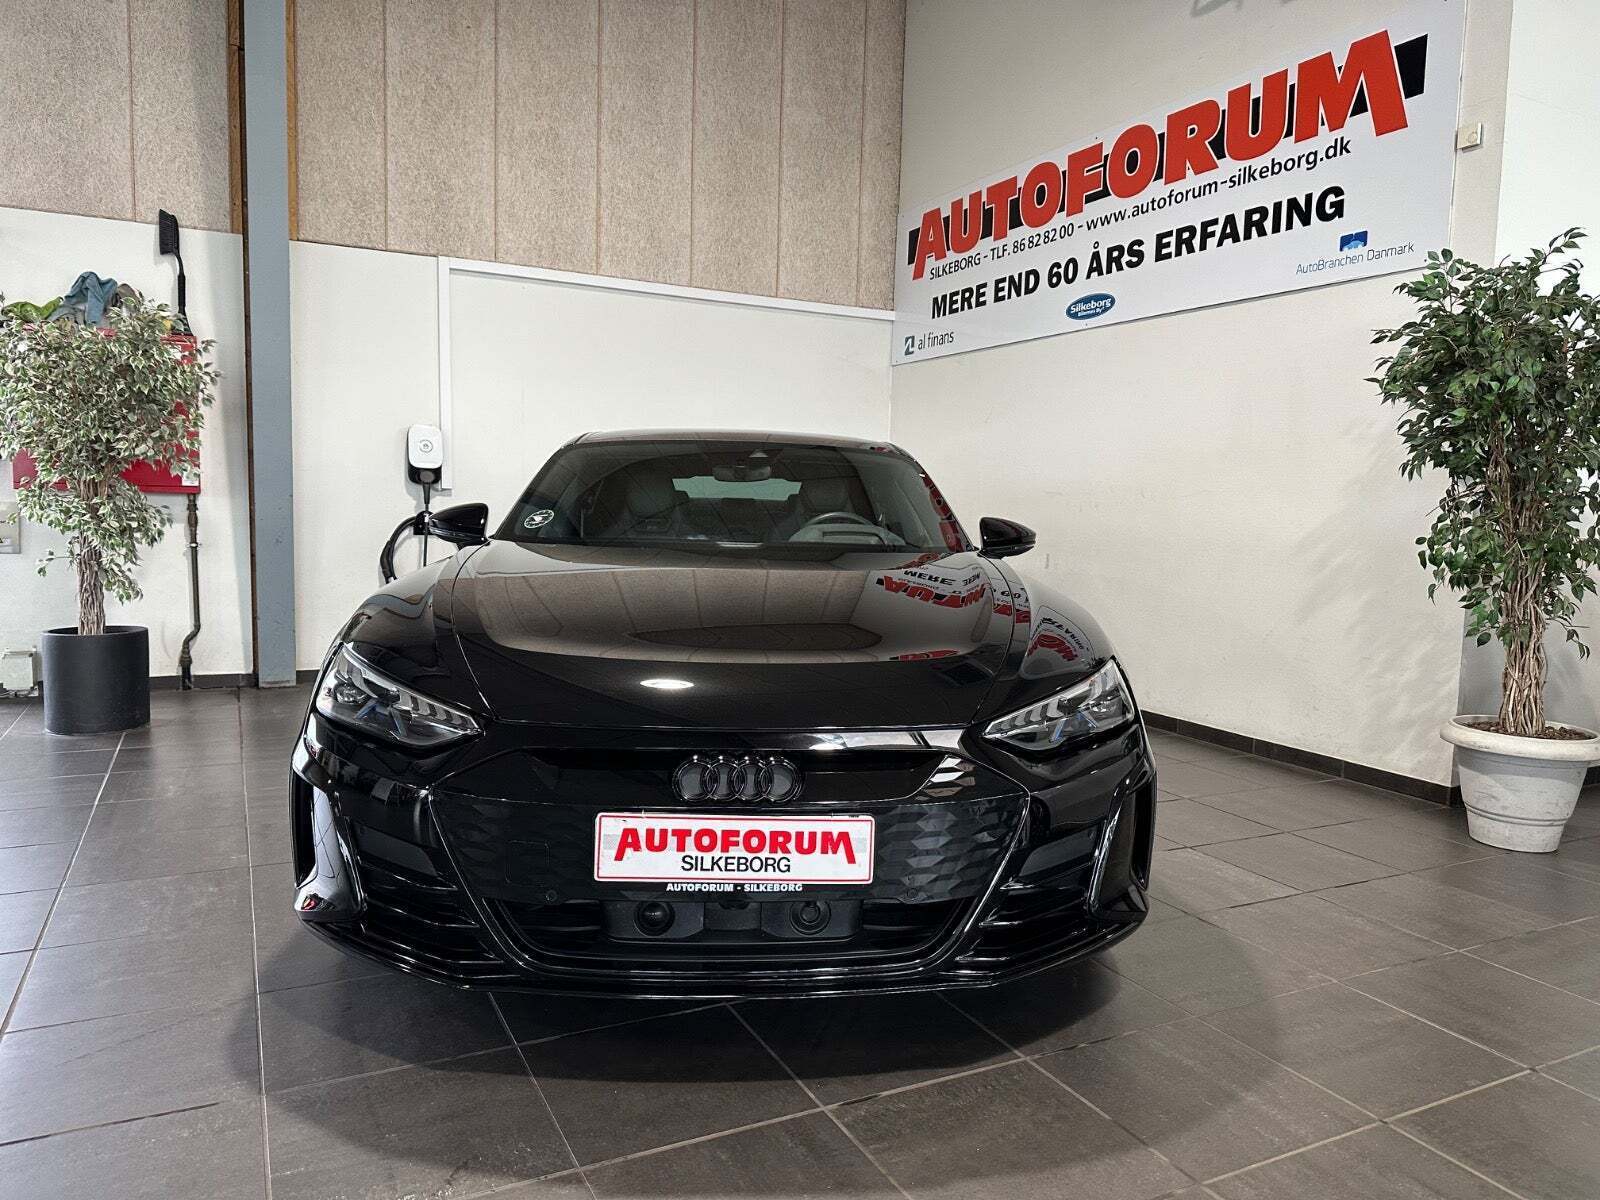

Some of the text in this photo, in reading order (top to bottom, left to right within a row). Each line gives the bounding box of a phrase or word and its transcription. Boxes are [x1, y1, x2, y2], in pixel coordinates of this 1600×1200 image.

[911, 29, 1408, 280] AUTOFORUM
[929, 252, 981, 280] SILKEBORG
[990, 244, 1011, 261] TLF.
[1086, 136, 1352, 232] www.autoforum-silkeborg.dk
[931, 185, 1345, 319] MERE END 60 ÅRS ERFARING
[1296, 242, 1415, 275] AutoBranchen Danmark
[1070, 298, 1112, 314] Silkeborg
[928, 331, 955, 348] finans
[613, 827, 857, 865] AUTOFORUM
[680, 854, 792, 874] SILKEBORG
[665, 882, 734, 892] AUTOFORUM
[743, 882, 803, 892] SILKEBORG
